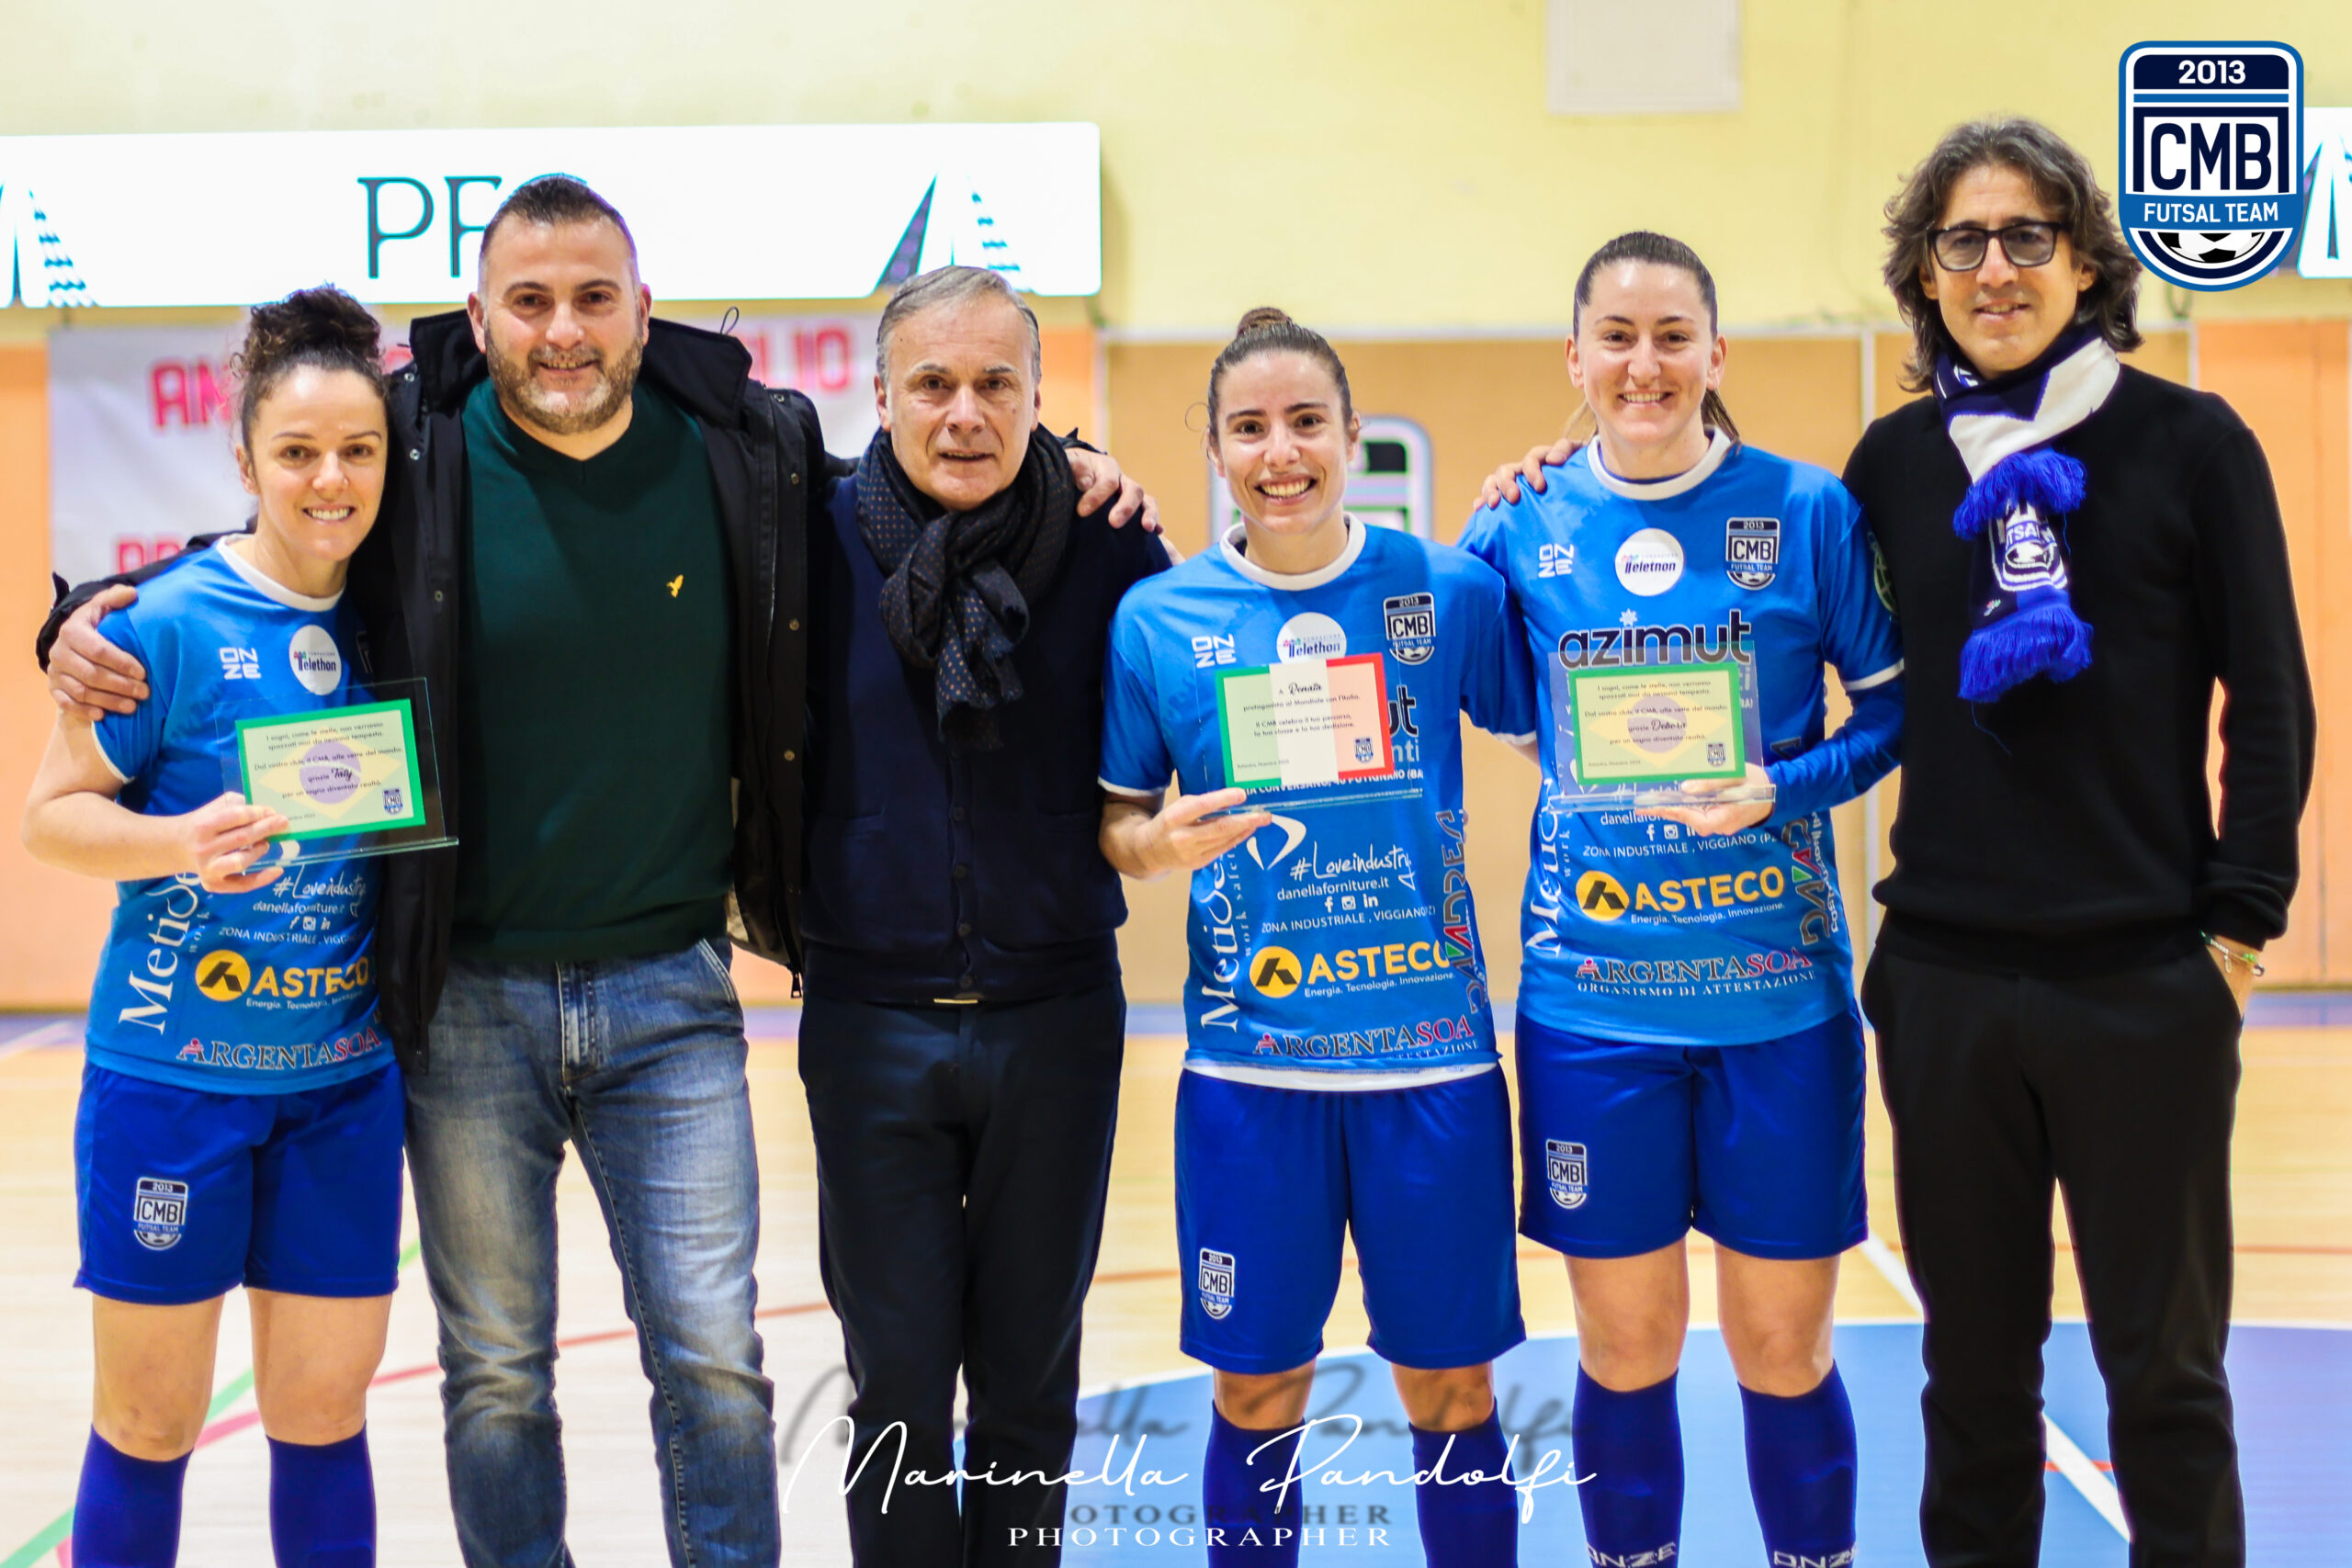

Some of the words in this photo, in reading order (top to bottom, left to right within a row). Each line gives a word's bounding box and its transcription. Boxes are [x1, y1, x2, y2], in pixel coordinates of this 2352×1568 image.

[1744, 520, 1764, 530] 2013
[1733, 540, 1772, 560] CMB
[1757, 562, 1773, 570] TEAM
[1393, 615, 1429, 637] CMB
[1285, 639, 1340, 659] Telethon
[1558, 608, 1752, 671] azimut
[295, 651, 336, 671] Telethon
[1613, 841, 1689, 858] INDUSTRIALE
[1697, 833, 1757, 852] VIGGIANO
[1277, 875, 1390, 901] danellaforniture.it
[1635, 866, 1785, 913] ASTECO
[1261, 921, 1287, 934] ZONA
[1291, 912, 1365, 932] INDUSTRIALE
[1631, 913, 1671, 926] Energia.
[1672, 910, 1727, 925] Tecnologia.
[1727, 901, 1786, 918] Innovazione.
[253, 930, 318, 945] INDUSTRIALE
[252, 956, 369, 998] ASTECO
[1576, 947, 1814, 986] ARGENTASOA
[1305, 983, 1343, 998] Energia.
[1346, 977, 1397, 993] Tecnologia.
[1399, 971, 1456, 985] Innovazione.
[1577, 983, 1673, 998] ORGANISMO
[1679, 987, 1697, 998] DI
[1702, 971, 1816, 996] ATTESTAZIONE
[246, 997, 283, 1010] Energia.
[1253, 1014, 1475, 1057] ARGENTASOA
[176, 1026, 382, 1070] ARGENTASOA
[1551, 1161, 1580, 1183] CMB
[141, 1200, 178, 1223] CMB
[1203, 1270, 1228, 1293] CMB
